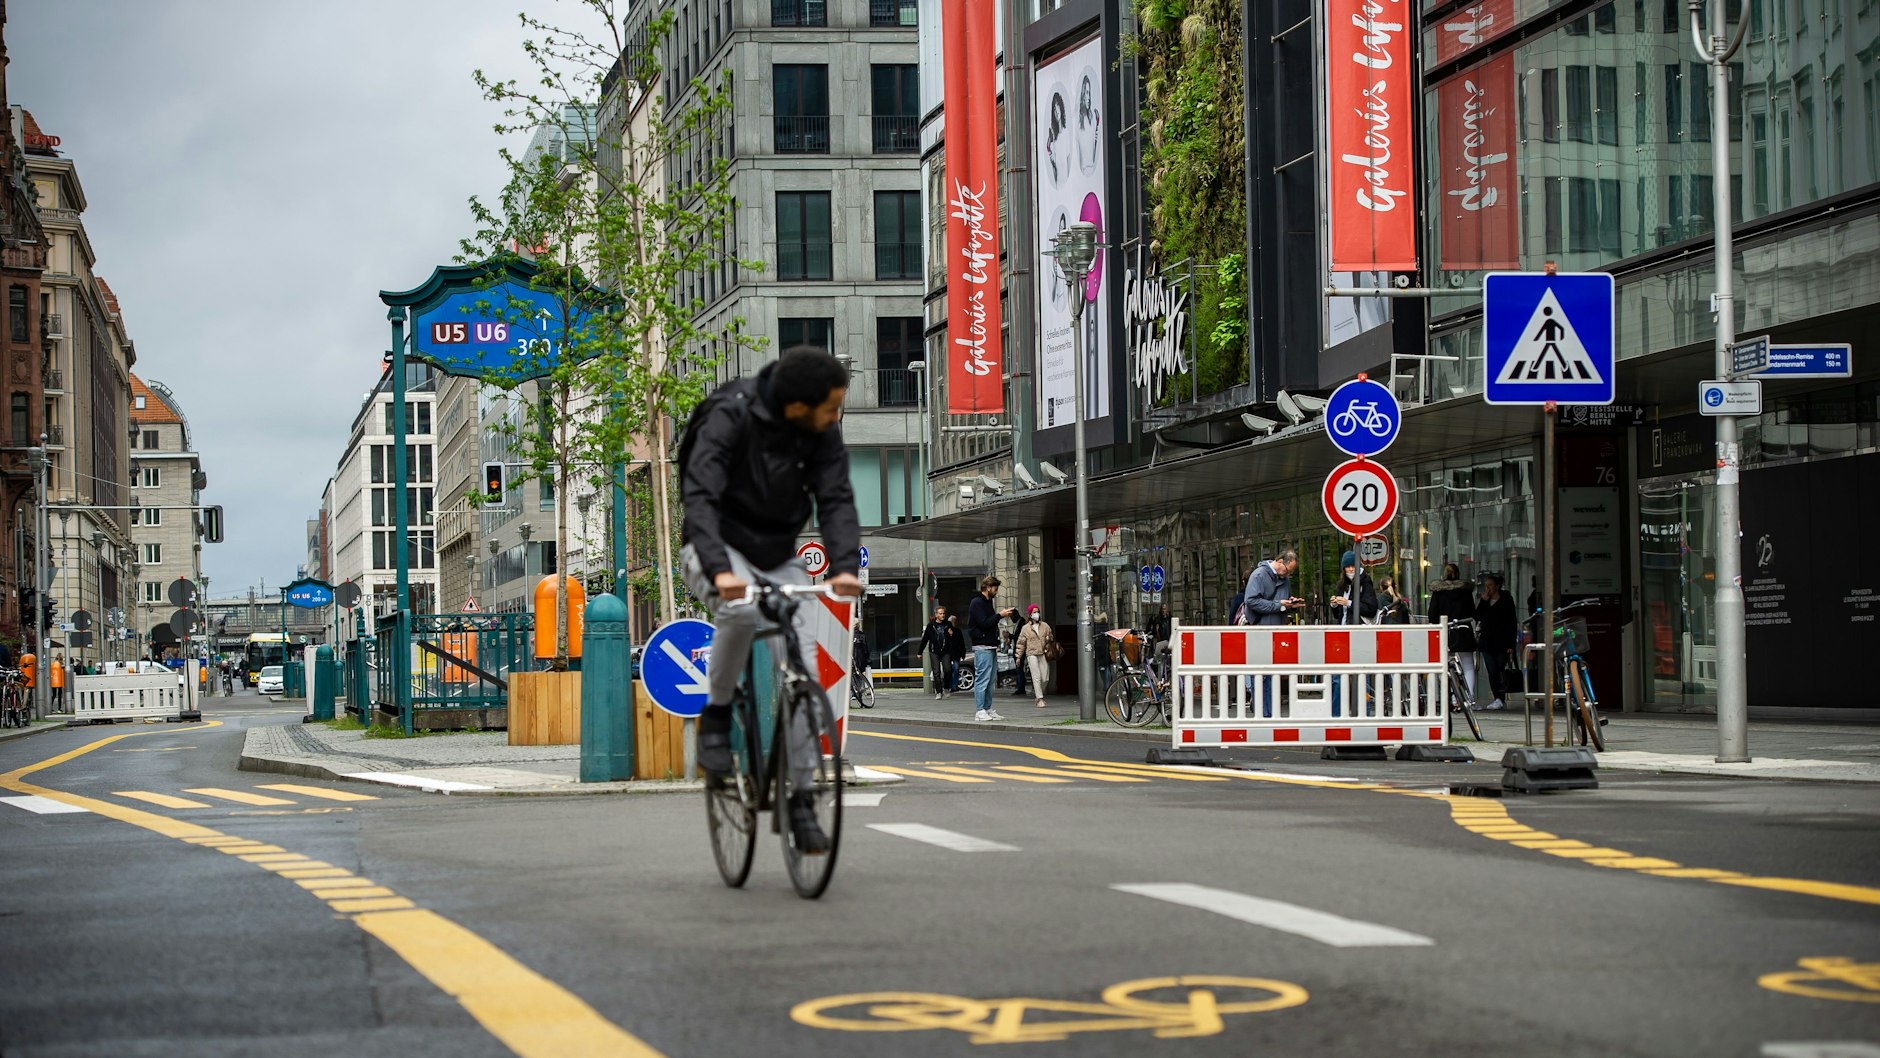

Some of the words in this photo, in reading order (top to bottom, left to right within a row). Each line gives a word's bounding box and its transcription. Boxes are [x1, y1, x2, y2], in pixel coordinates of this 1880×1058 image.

[1342, 80, 1407, 213] Galeries
[951, 177, 995, 285] Lafayette
[435, 324, 465, 342] U5
[477, 323, 507, 341] U6
[955, 290, 998, 376] Galeries
[1595, 466, 1616, 484] 76
[1341, 482, 1379, 512] 20
[804, 552, 822, 565] 50
